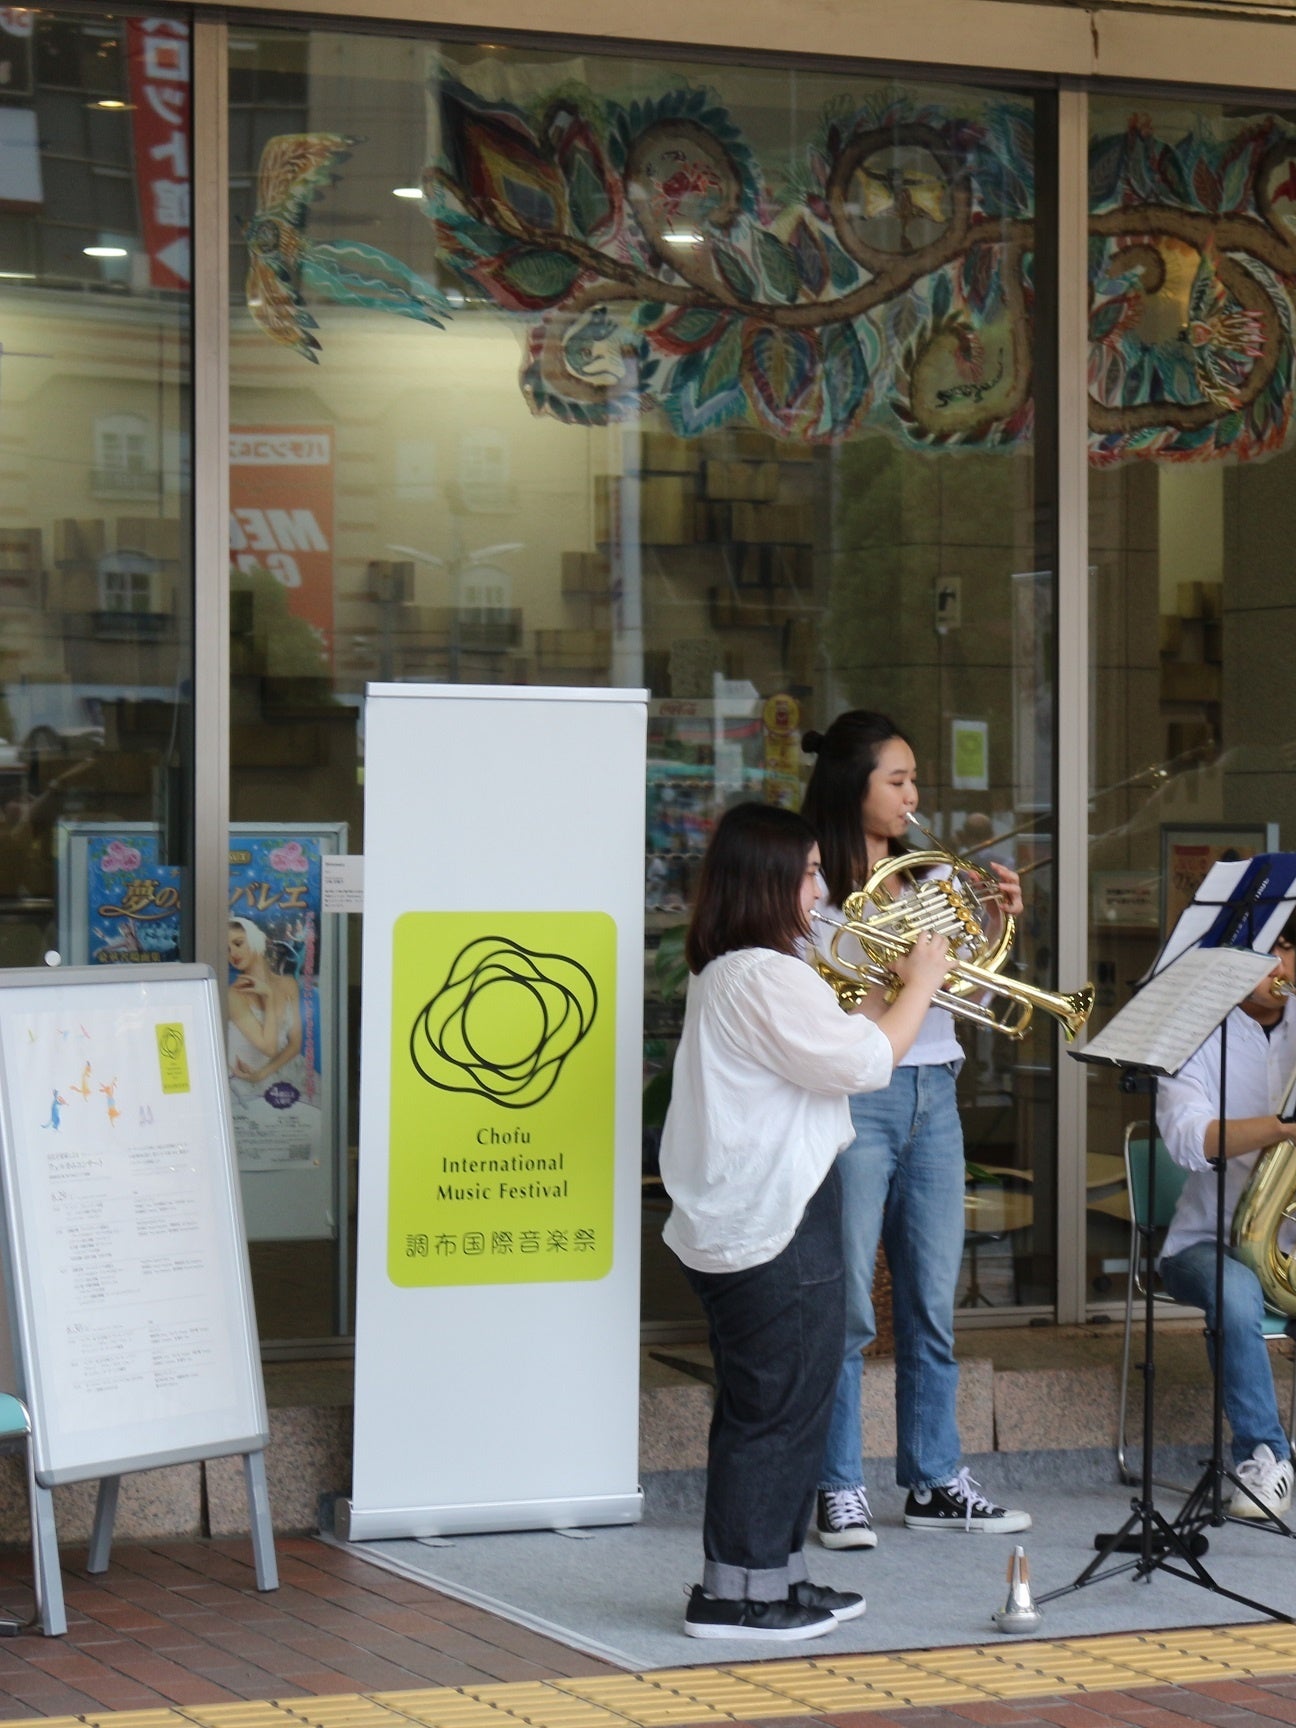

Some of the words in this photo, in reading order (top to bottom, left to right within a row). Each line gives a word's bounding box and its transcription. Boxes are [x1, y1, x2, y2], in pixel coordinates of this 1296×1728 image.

[476, 1126, 531, 1145] Chofu
[442, 1152, 564, 1173] International
[437, 1183, 491, 1201] Music
[499, 1180, 568, 1199] Festival
[406, 1228, 596, 1258] 調布国際音楽祭
